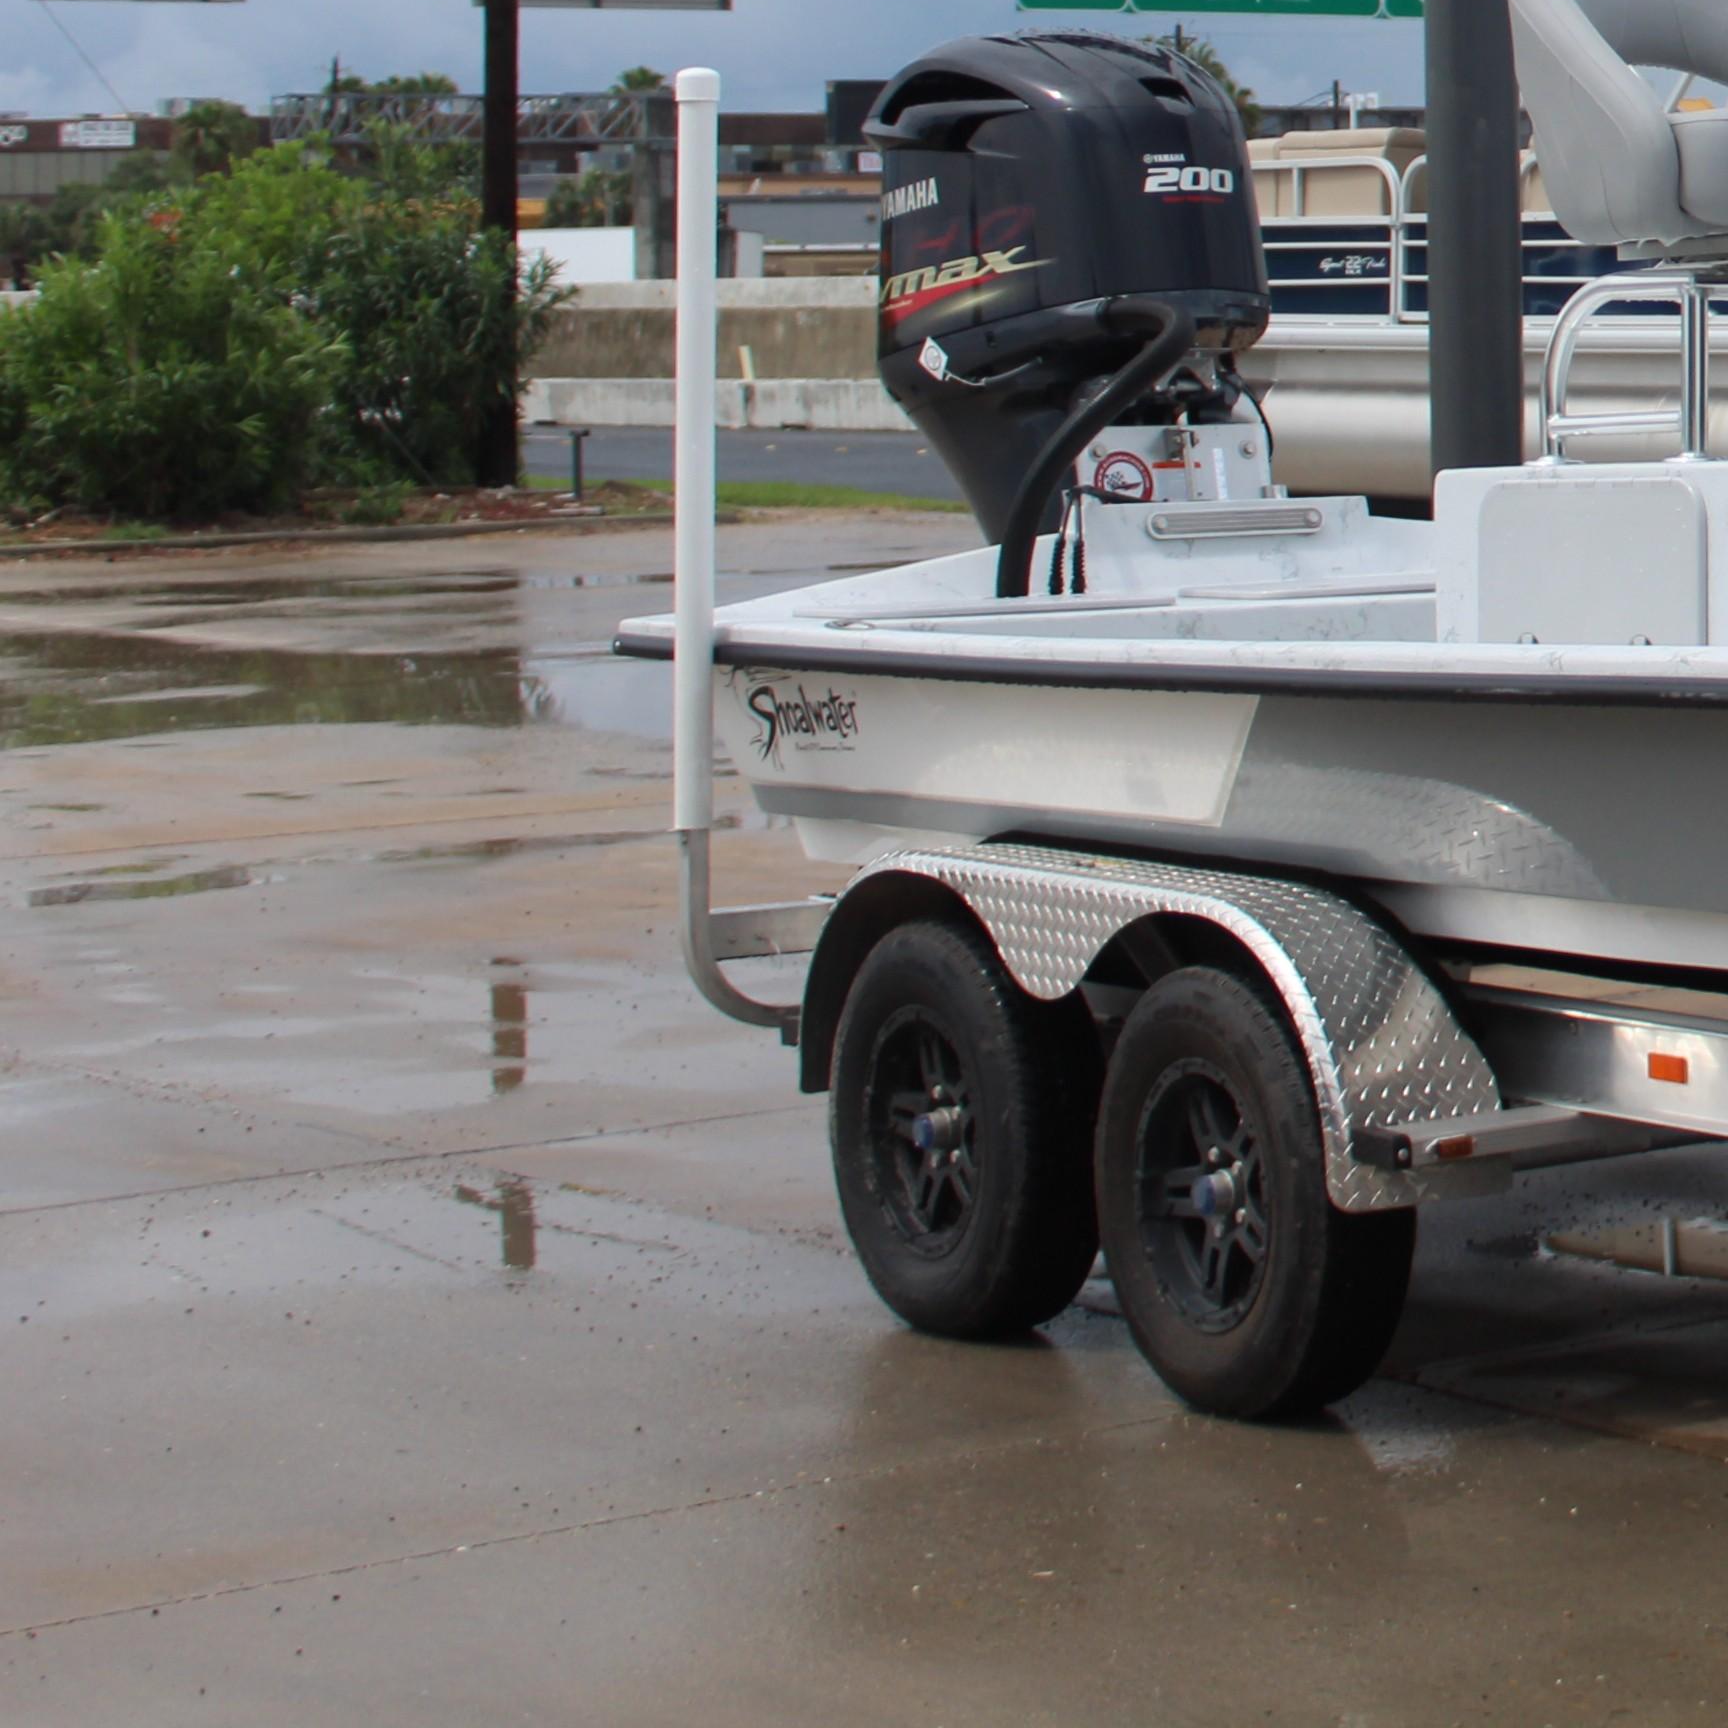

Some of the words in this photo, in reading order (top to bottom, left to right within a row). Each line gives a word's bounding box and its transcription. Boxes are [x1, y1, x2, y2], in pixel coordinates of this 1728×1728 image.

[1153, 153, 1186, 163] YAMAHA
[1144, 167, 1233, 193] 200
[882, 177, 939, 221] YAMAHA
[748, 683, 858, 760] Shoalwater
